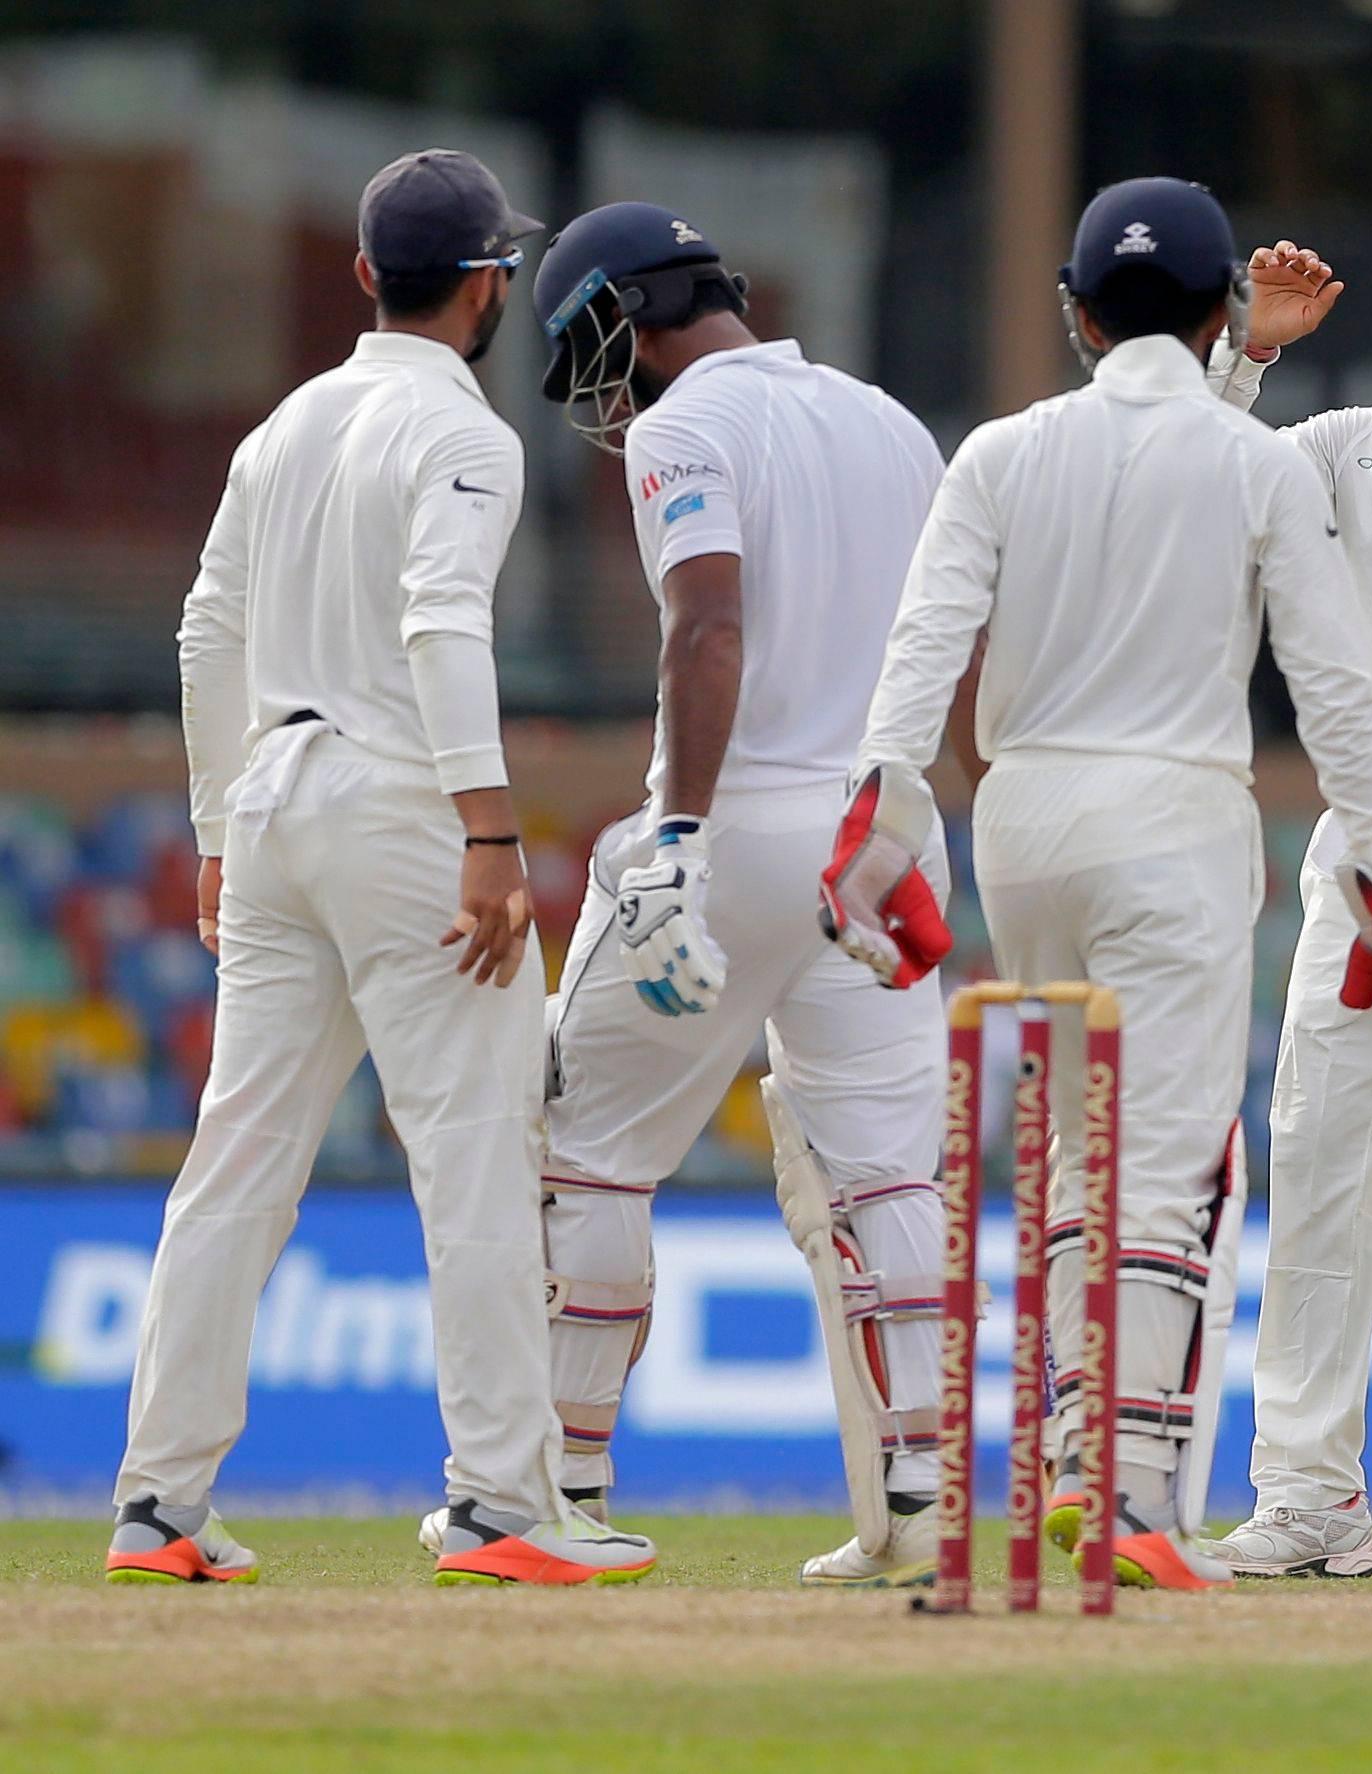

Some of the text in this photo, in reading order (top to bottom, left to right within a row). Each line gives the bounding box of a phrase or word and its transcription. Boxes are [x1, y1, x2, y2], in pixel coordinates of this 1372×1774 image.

[941, 1058, 972, 1281] ROYAL STAG
[1014, 1156, 1043, 1277] ROYAL
[1082, 1060, 1115, 1284] ROYAL STAG
[936, 1317, 968, 1540] ROYAL STAG
[1006, 1312, 1040, 1540] ROYAL STAG
[1078, 1320, 1106, 1543] ROYAL STAG
